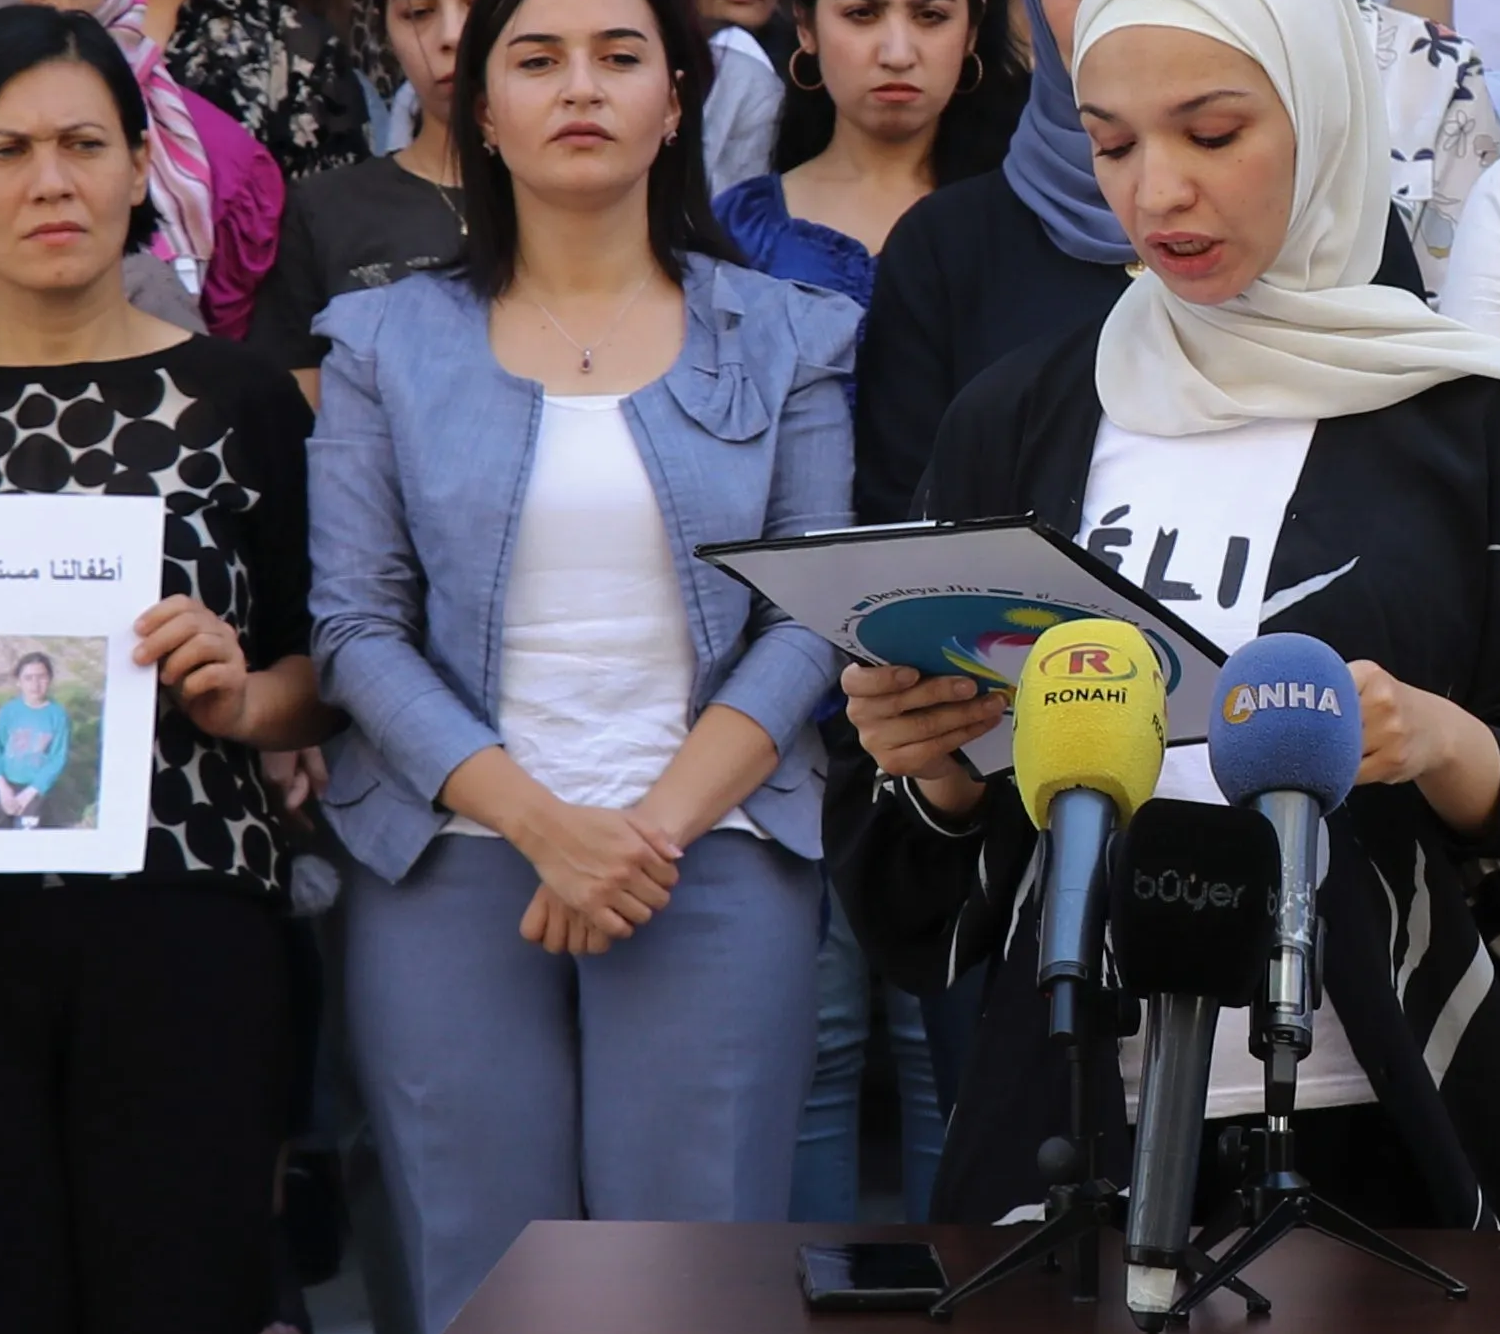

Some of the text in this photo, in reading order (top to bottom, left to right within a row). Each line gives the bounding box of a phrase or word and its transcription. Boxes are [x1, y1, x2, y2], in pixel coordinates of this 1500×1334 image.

[49, 554, 123, 582] أطفالنا
[866, 587, 940, 604] Desteya
[1069, 650, 1113, 674] R
[1233, 682, 1342, 716] ANHA
